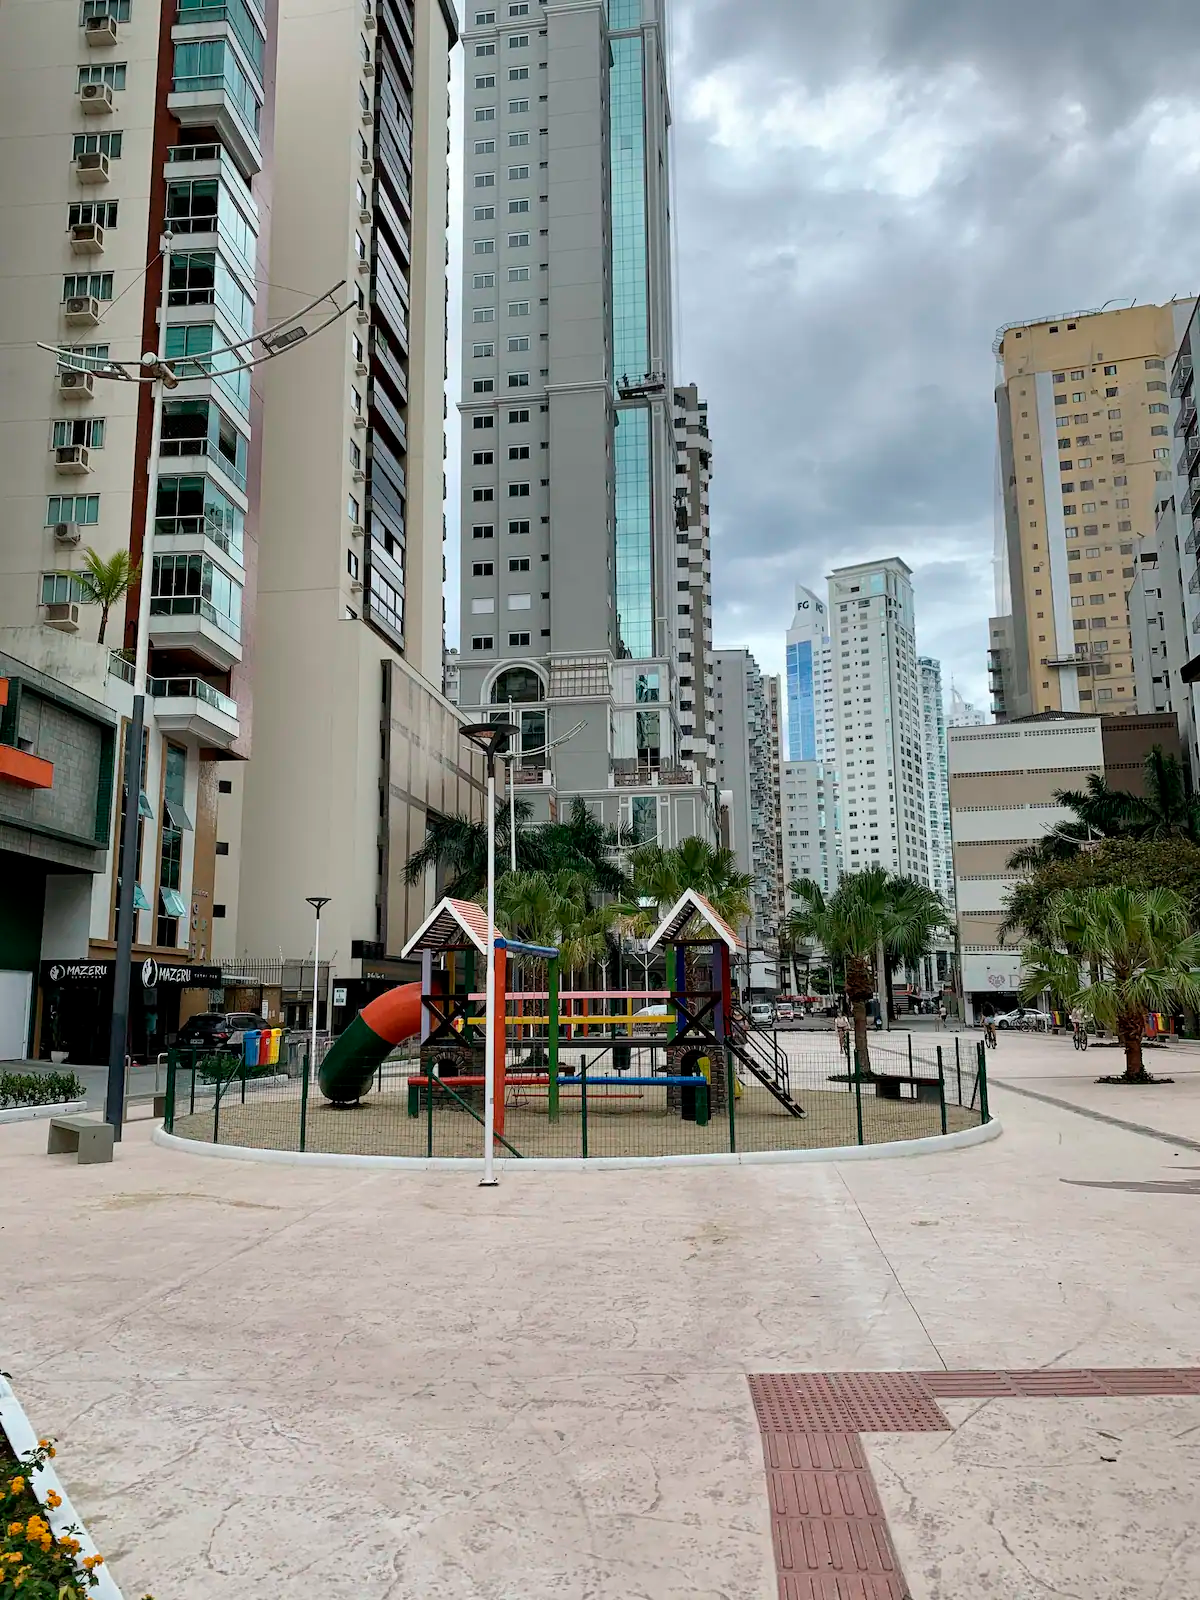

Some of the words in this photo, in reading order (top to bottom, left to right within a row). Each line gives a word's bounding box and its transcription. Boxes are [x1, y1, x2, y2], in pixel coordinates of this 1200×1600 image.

[797, 600, 809, 611] FG
[66, 964, 105, 976] MAZERU
[159, 967, 191, 982] MAZERU
